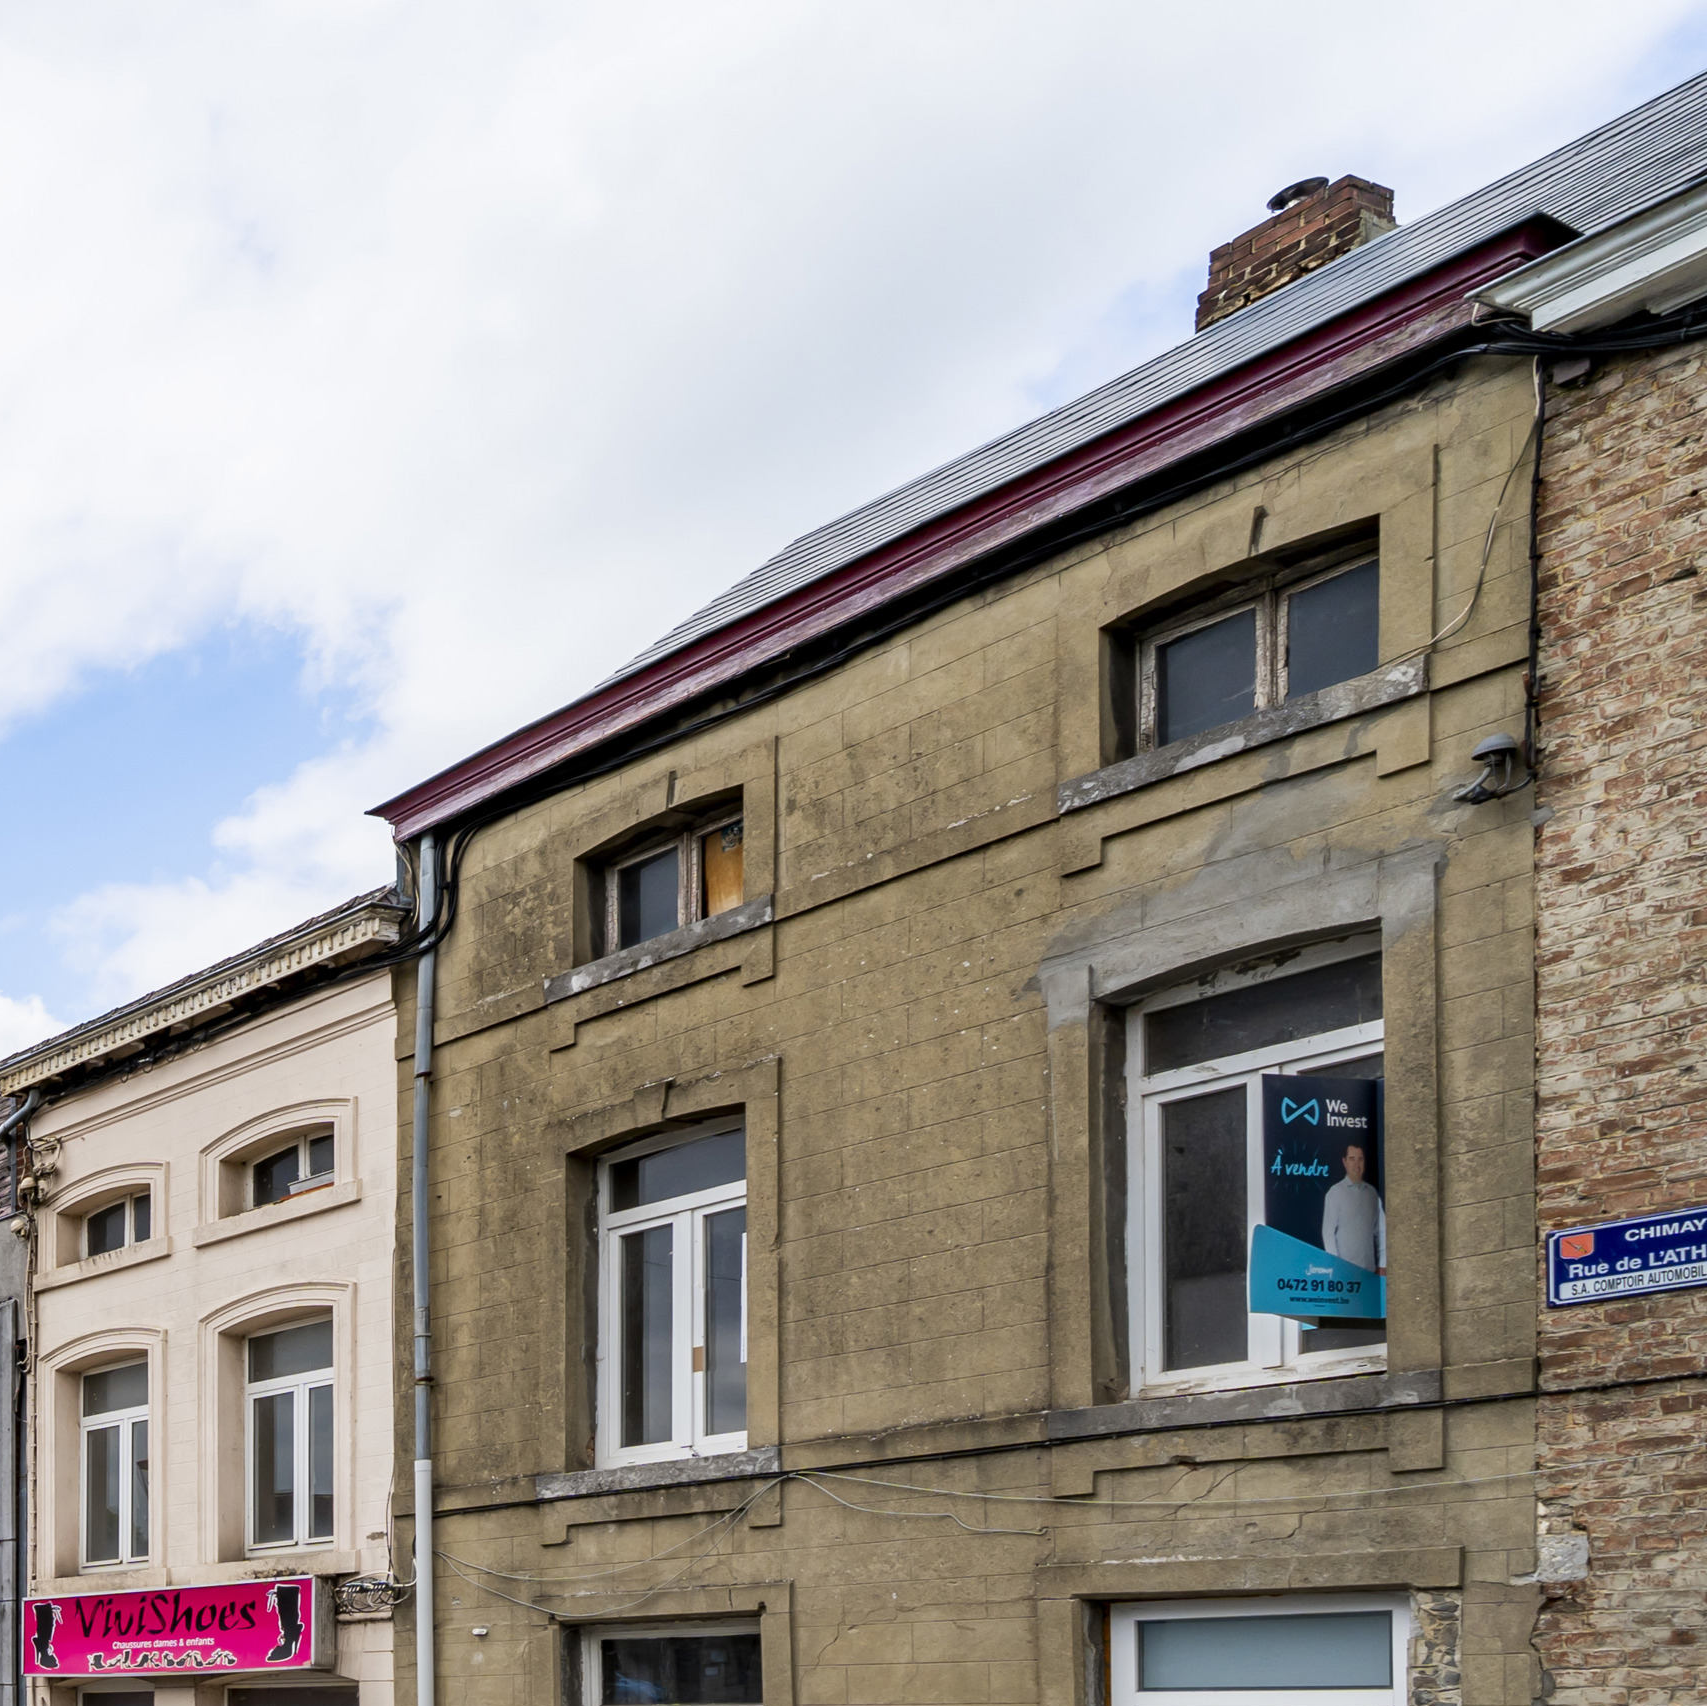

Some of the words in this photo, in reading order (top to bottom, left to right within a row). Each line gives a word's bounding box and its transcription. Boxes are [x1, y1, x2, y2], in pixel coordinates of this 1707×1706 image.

[1326, 1099, 1348, 1113] We
[1327, 1113, 1367, 1128] Invest
[1271, 1149, 1283, 1176] À
[1285, 1158, 1329, 1177] vendre
[1624, 1218, 1707, 1241] CHIMAY
[1569, 1262, 1609, 1279] Rue
[1615, 1256, 1642, 1271] de
[1649, 1243, 1707, 1267] L'ATH
[1277, 1278, 1308, 1291] 0472
[1311, 1279, 1325, 1292] 91
[1328, 1280, 1344, 1293] 80
[1346, 1281, 1362, 1293] 37
[1571, 1283, 1590, 1296] S.A.
[1593, 1274, 1644, 1293] COMPTOIR
[1648, 1265, 1707, 1285] AUTOMOBIL
[75, 1592, 257, 1638] ViviShoes
[112, 1640, 151, 1650] Chaussures
[153, 1638, 177, 1648] dames
[179, 1638, 184, 1647] &
[185, 1637, 215, 1647] enfants
